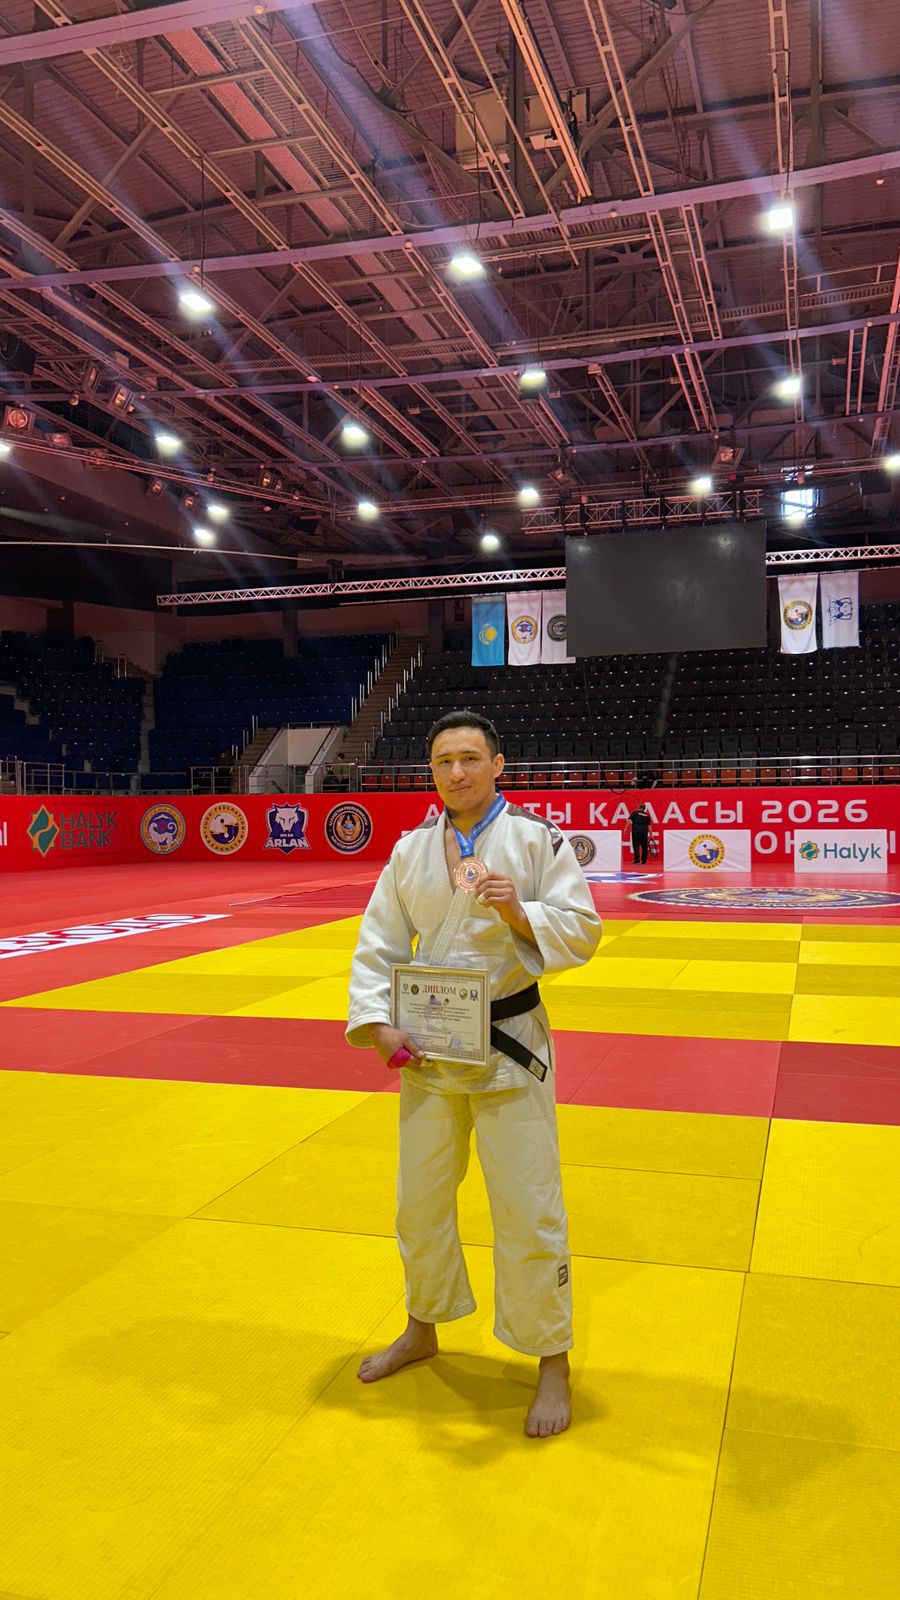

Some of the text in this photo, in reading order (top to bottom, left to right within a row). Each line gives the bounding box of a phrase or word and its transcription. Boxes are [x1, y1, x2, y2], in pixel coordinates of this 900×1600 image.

[60, 811, 119, 830] HALYK
[422, 802, 572, 824] АТЫ
[761, 799, 869, 823] 2026
[60, 829, 113, 849] BANK
[823, 843, 882, 862] Halyk
[422, 984, 456, 995] ДИПЛОМ
